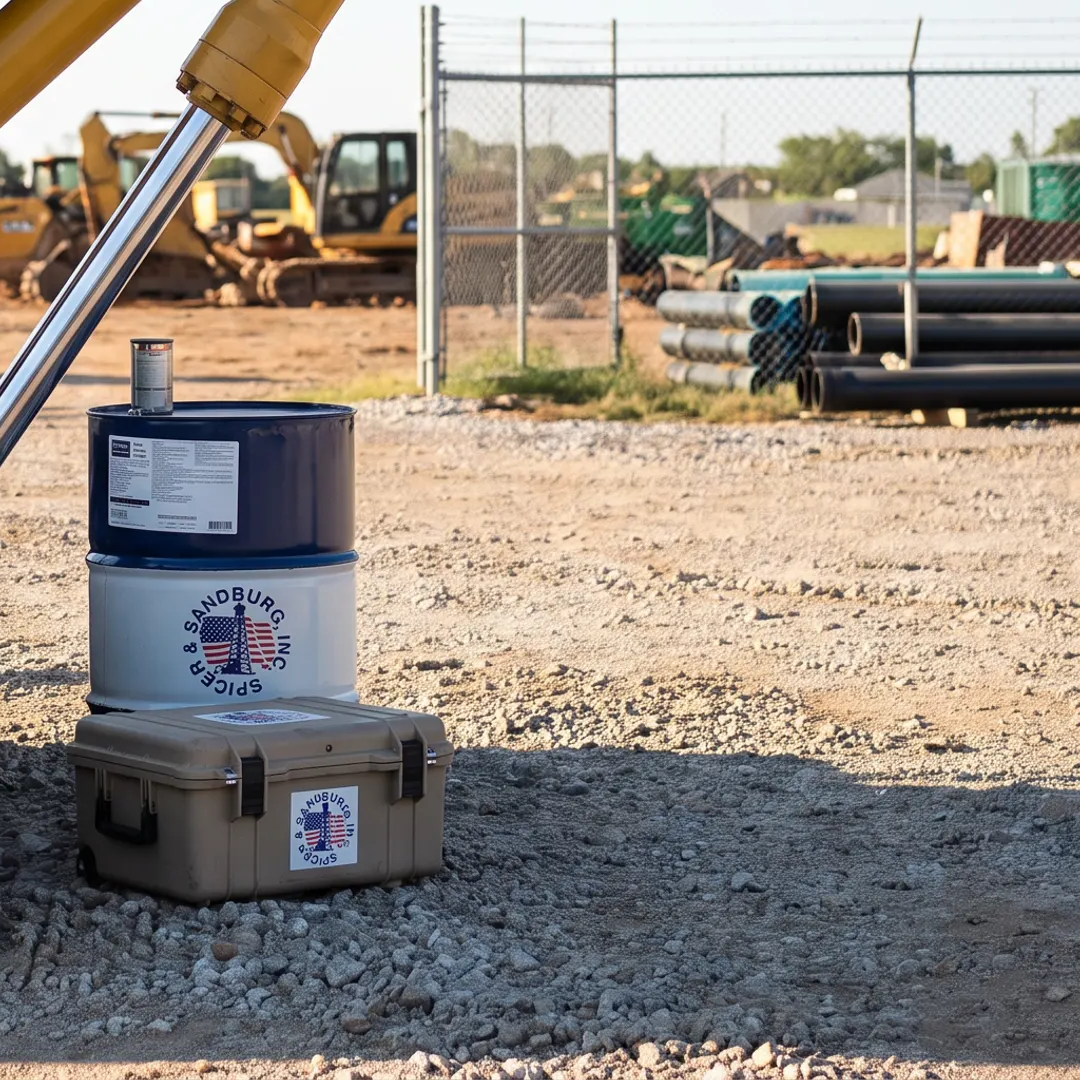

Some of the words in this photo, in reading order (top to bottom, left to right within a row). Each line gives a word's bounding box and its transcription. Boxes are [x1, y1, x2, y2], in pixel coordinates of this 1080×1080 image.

[184, 586, 285, 634] SANDBURG,
[183, 642, 198, 654] &
[267, 635, 291, 671] INC.
[189, 660, 263, 696] SPICER
